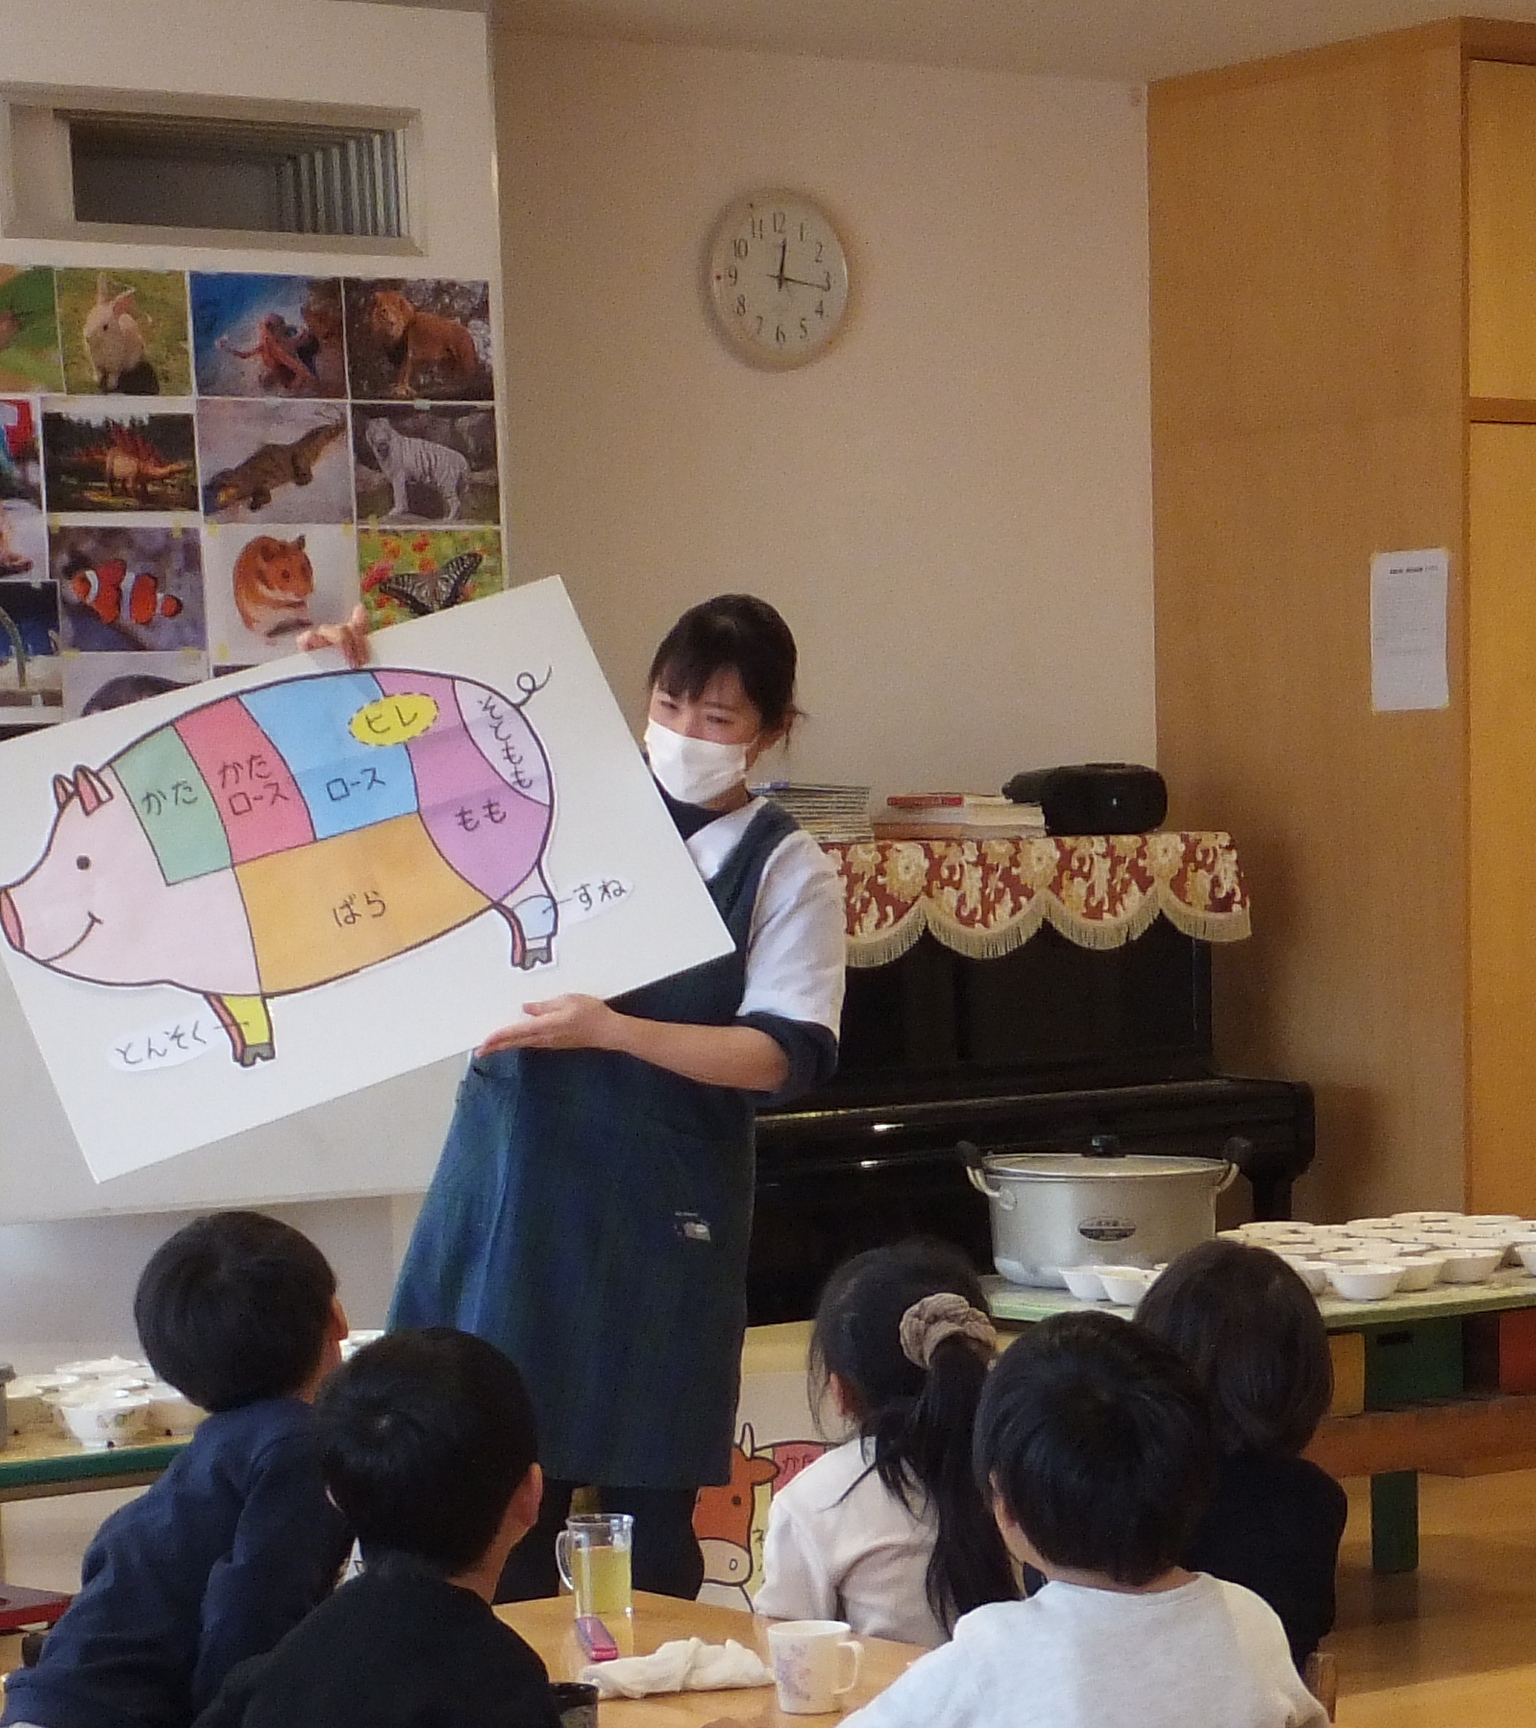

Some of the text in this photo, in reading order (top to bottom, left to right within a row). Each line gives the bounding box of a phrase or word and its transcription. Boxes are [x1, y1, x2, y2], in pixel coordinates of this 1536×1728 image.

[751, 217, 763, 239] 11
[773, 212, 786, 233] 12
[798, 222, 804, 241] 1
[734, 238, 748, 259] 10
[815, 242, 823, 263] 2
[728, 266, 738, 286] 9
[736, 294, 746, 316] 8
[815, 300, 824, 319] 4
[756, 316, 763, 335] 7
[776, 325, 786, 343] 6
[800, 318, 809, 339] 5
[364, 704, 419, 734] ヒレ
[477, 695, 533, 789] そともも
[218, 754, 273, 789] かた
[325, 766, 386, 801] ロース
[142, 779, 198, 816] かた
[228, 782, 289, 816] ロース
[455, 799, 507, 833] もも
[573, 879, 627, 911] すね
[332, 889, 387, 928] ばら
[115, 1020, 207, 1065] とんそく
